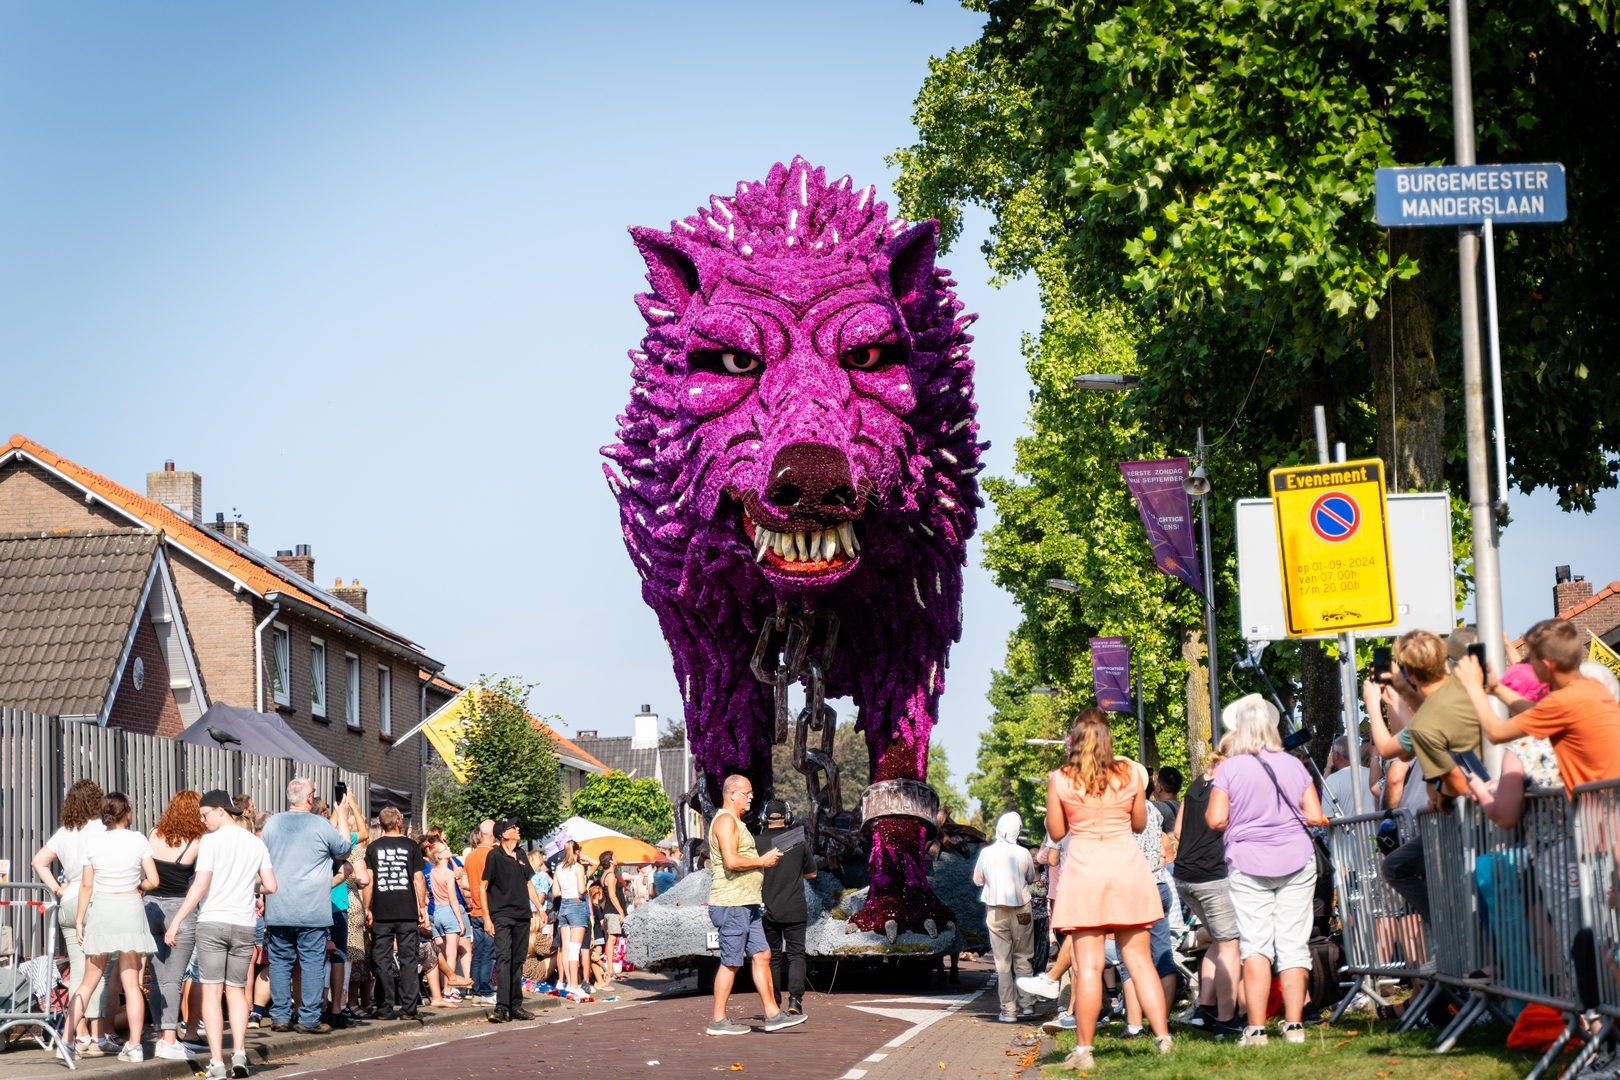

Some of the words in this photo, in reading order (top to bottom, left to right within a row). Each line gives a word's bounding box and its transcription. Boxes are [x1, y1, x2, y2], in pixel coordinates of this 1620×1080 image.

[1397, 171, 1549, 193] BURGEMEESTER
[1402, 195, 1545, 217] MANDERSLAAN
[1142, 476, 1184, 484] SEPTEMBER
[1286, 467, 1368, 489] Evenement
[1297, 565, 1309, 574] op
[1312, 556, 1375, 571] 01-09-2024
[1299, 575, 1317, 584] van
[1320, 570, 1357, 582] 07.00h
[1300, 585, 1320, 596] t/m
[1323, 581, 1360, 593] 20.00h
